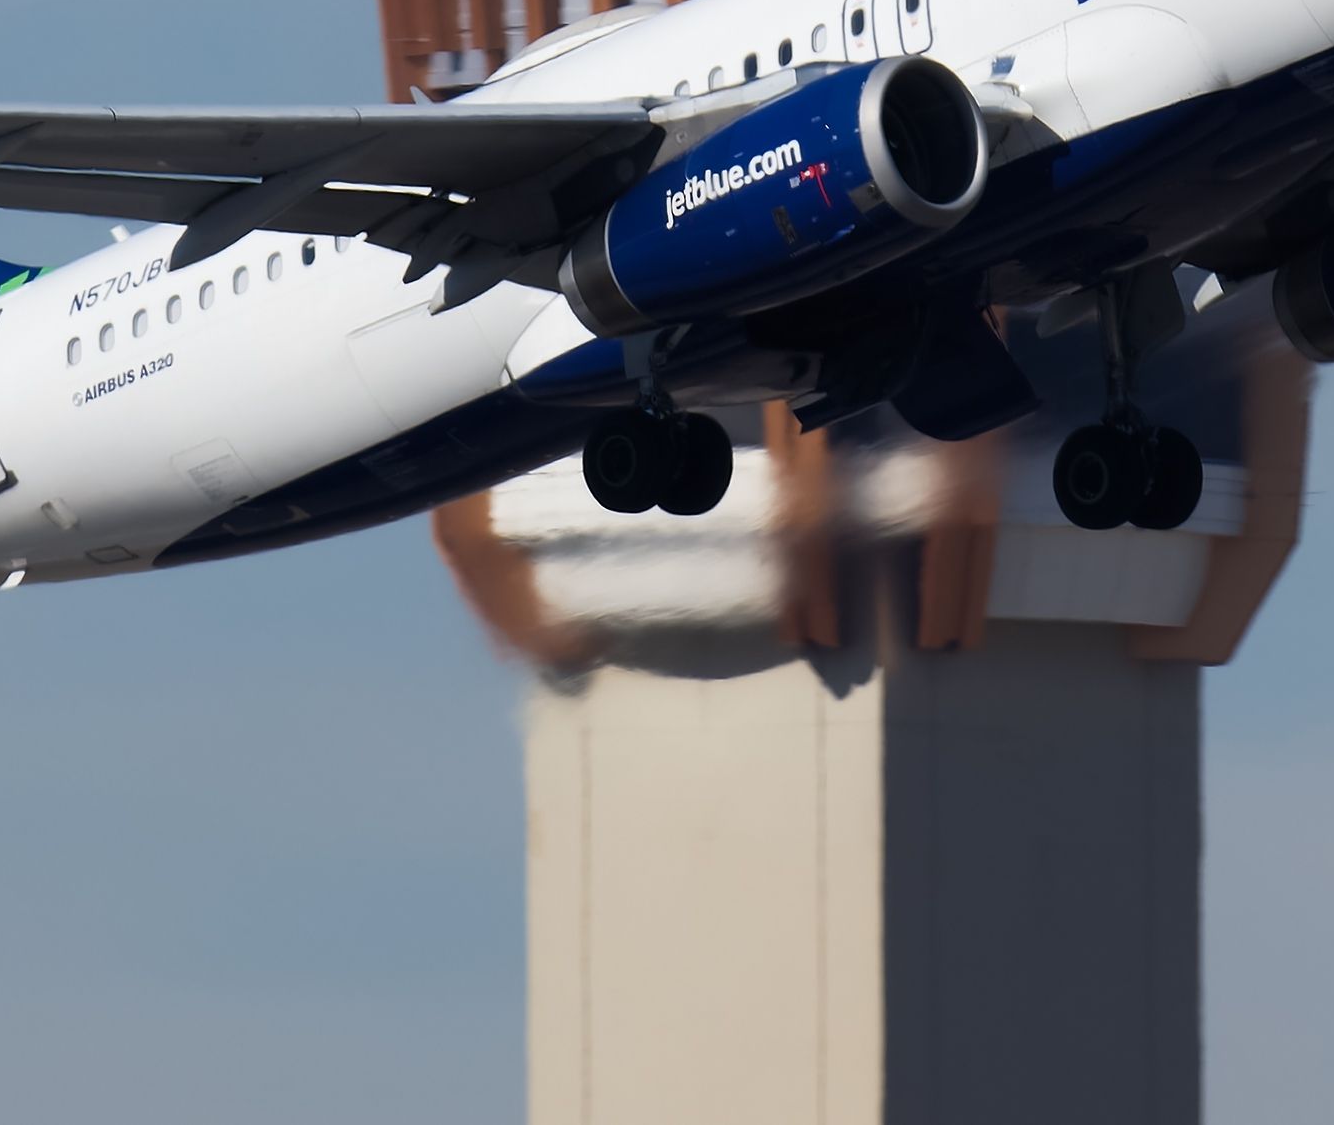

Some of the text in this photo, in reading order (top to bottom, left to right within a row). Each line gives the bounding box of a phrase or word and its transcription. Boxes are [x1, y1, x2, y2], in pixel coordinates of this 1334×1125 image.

[666, 139, 803, 230] jetblue.com
[69, 257, 163, 317] N570JB
[84, 352, 174, 404] AIRBUS A320
